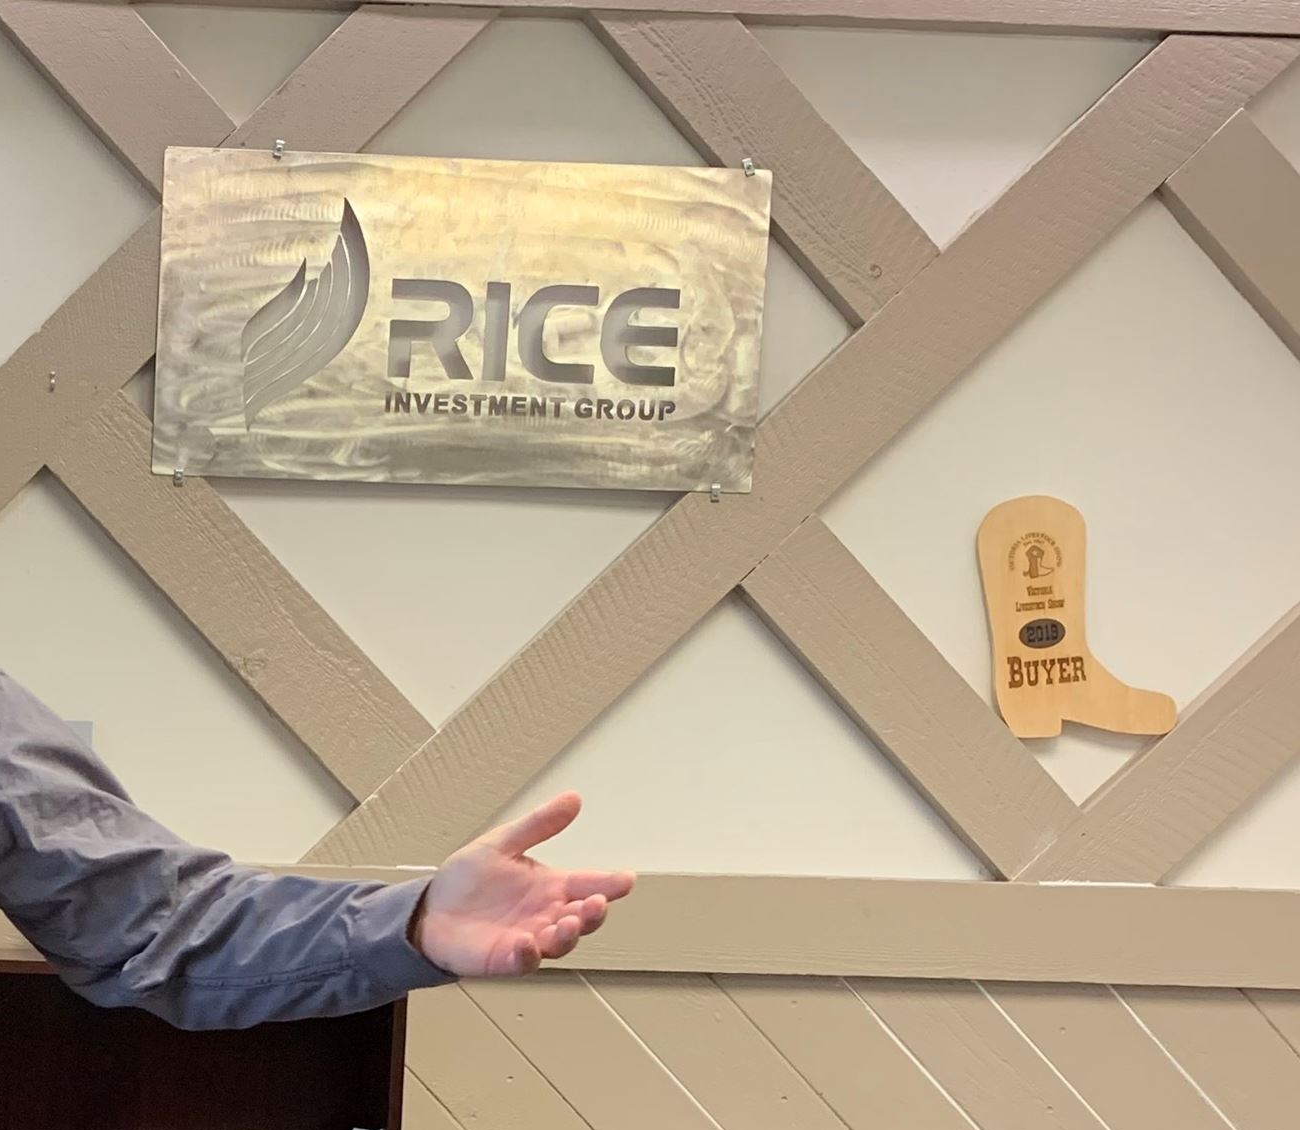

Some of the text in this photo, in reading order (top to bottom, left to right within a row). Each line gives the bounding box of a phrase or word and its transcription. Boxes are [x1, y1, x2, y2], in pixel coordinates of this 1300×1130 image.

[387, 278, 681, 387] RICE
[384, 391, 677, 422] INVESTMENT GROUP
[1007, 656, 1087, 689] BUYER
